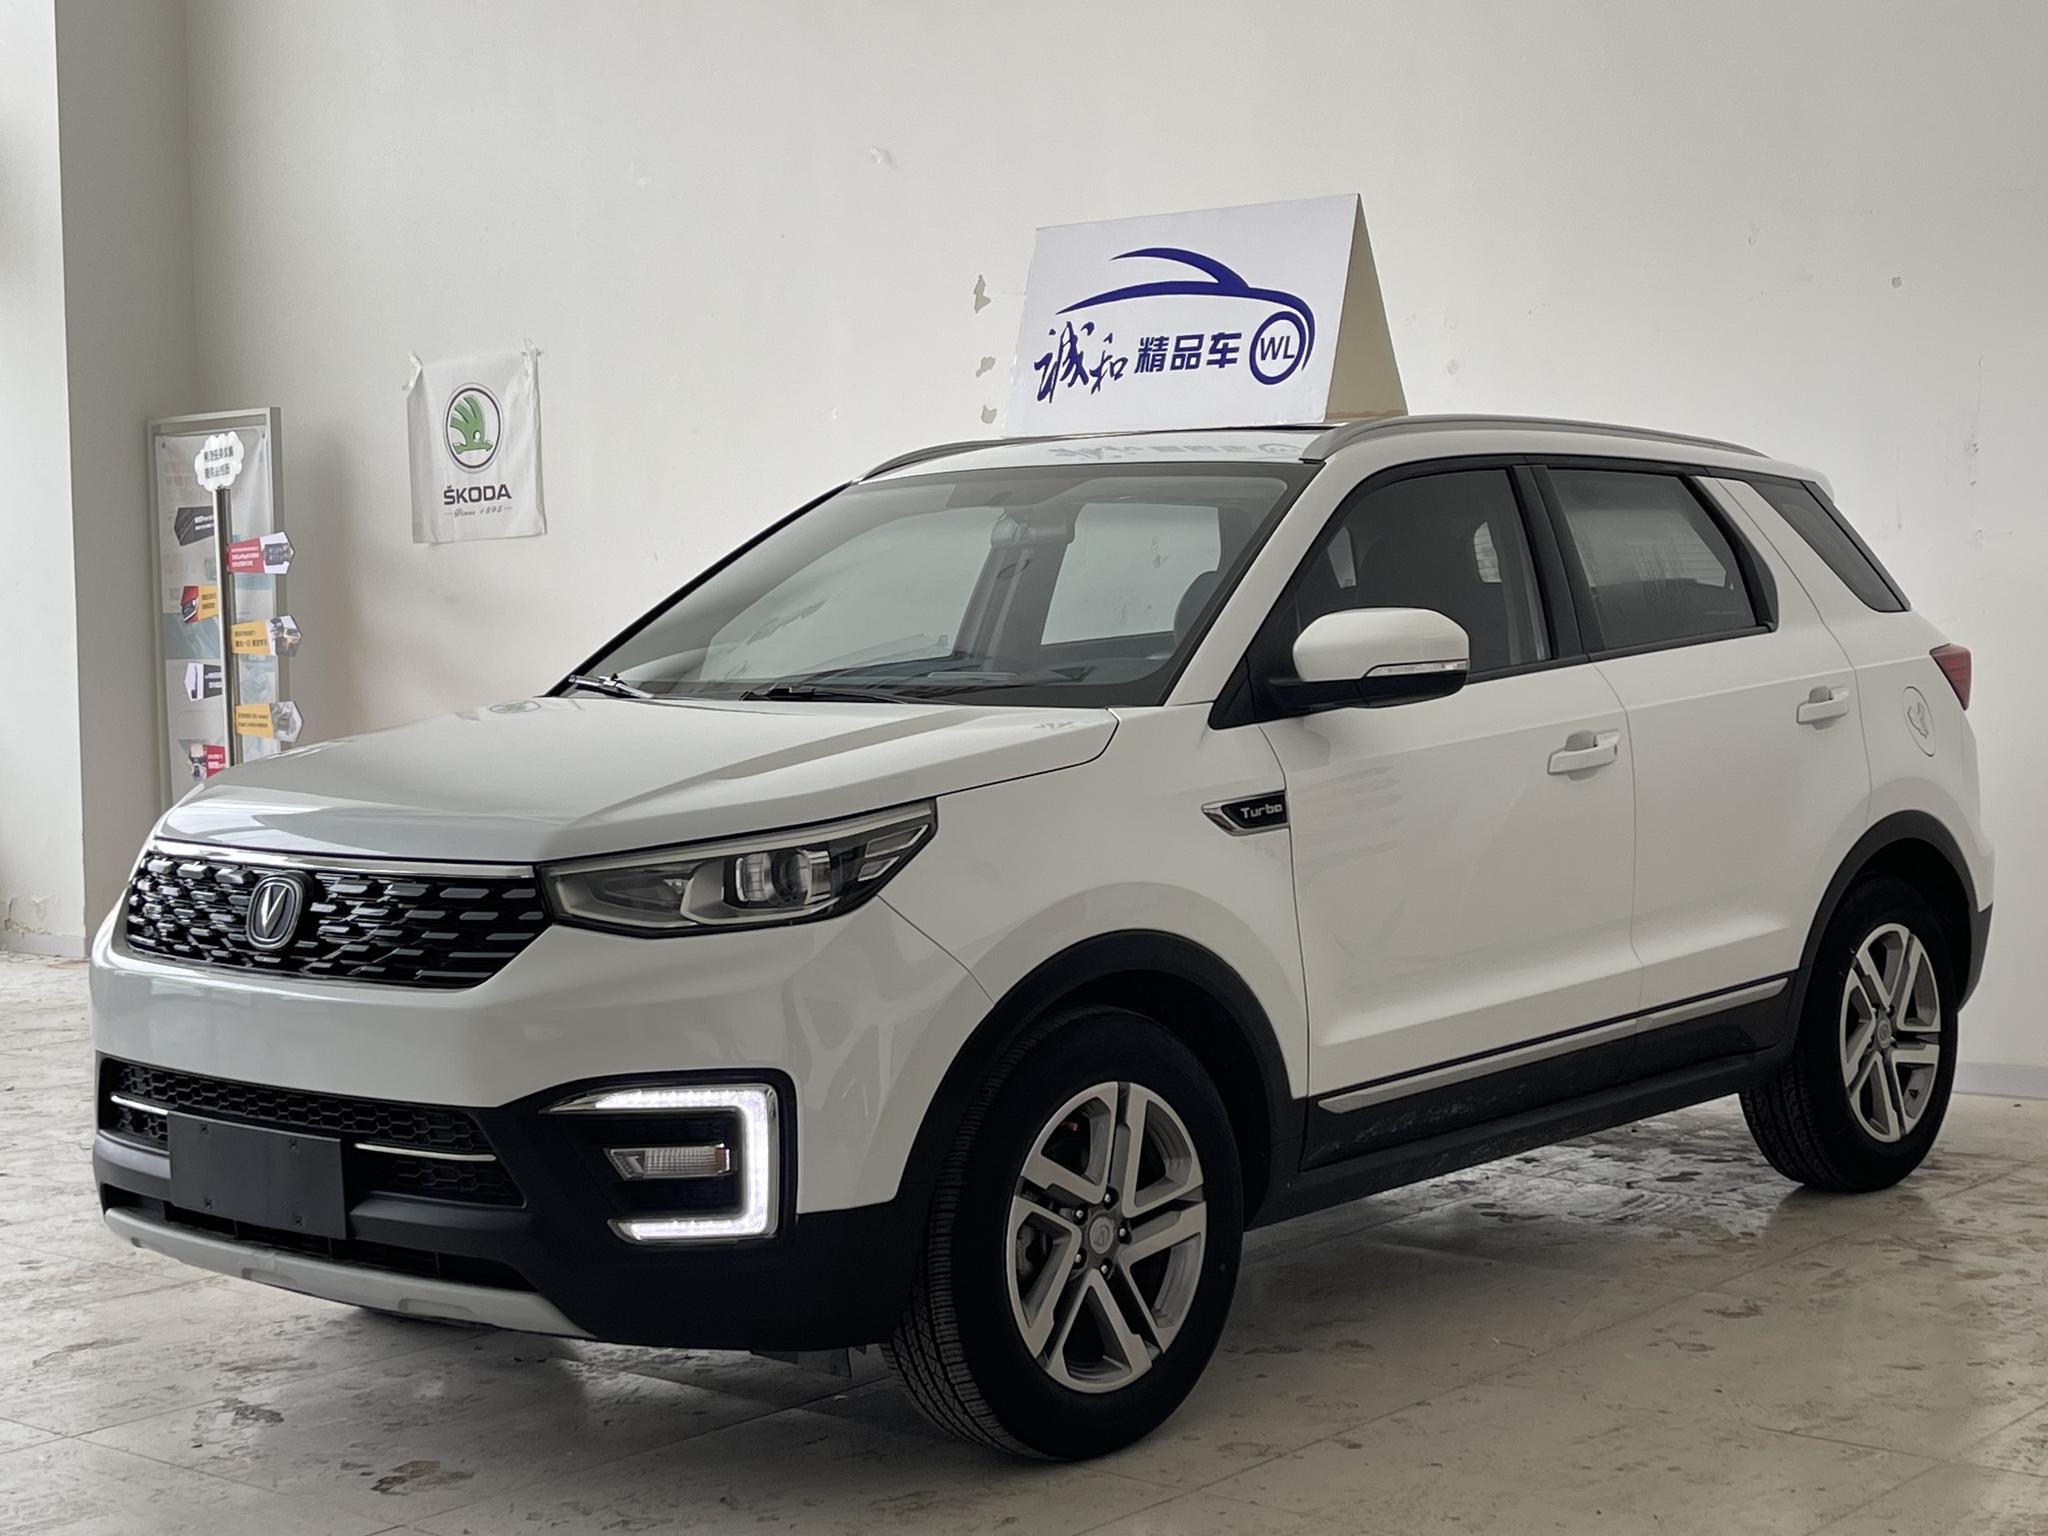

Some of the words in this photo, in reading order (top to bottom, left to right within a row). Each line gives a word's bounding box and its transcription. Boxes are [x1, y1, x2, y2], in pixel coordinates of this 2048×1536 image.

[1260, 335, 1295, 361] WL
[443, 484, 512, 505] ŠKODA
[1240, 804, 1283, 819] Turbo
